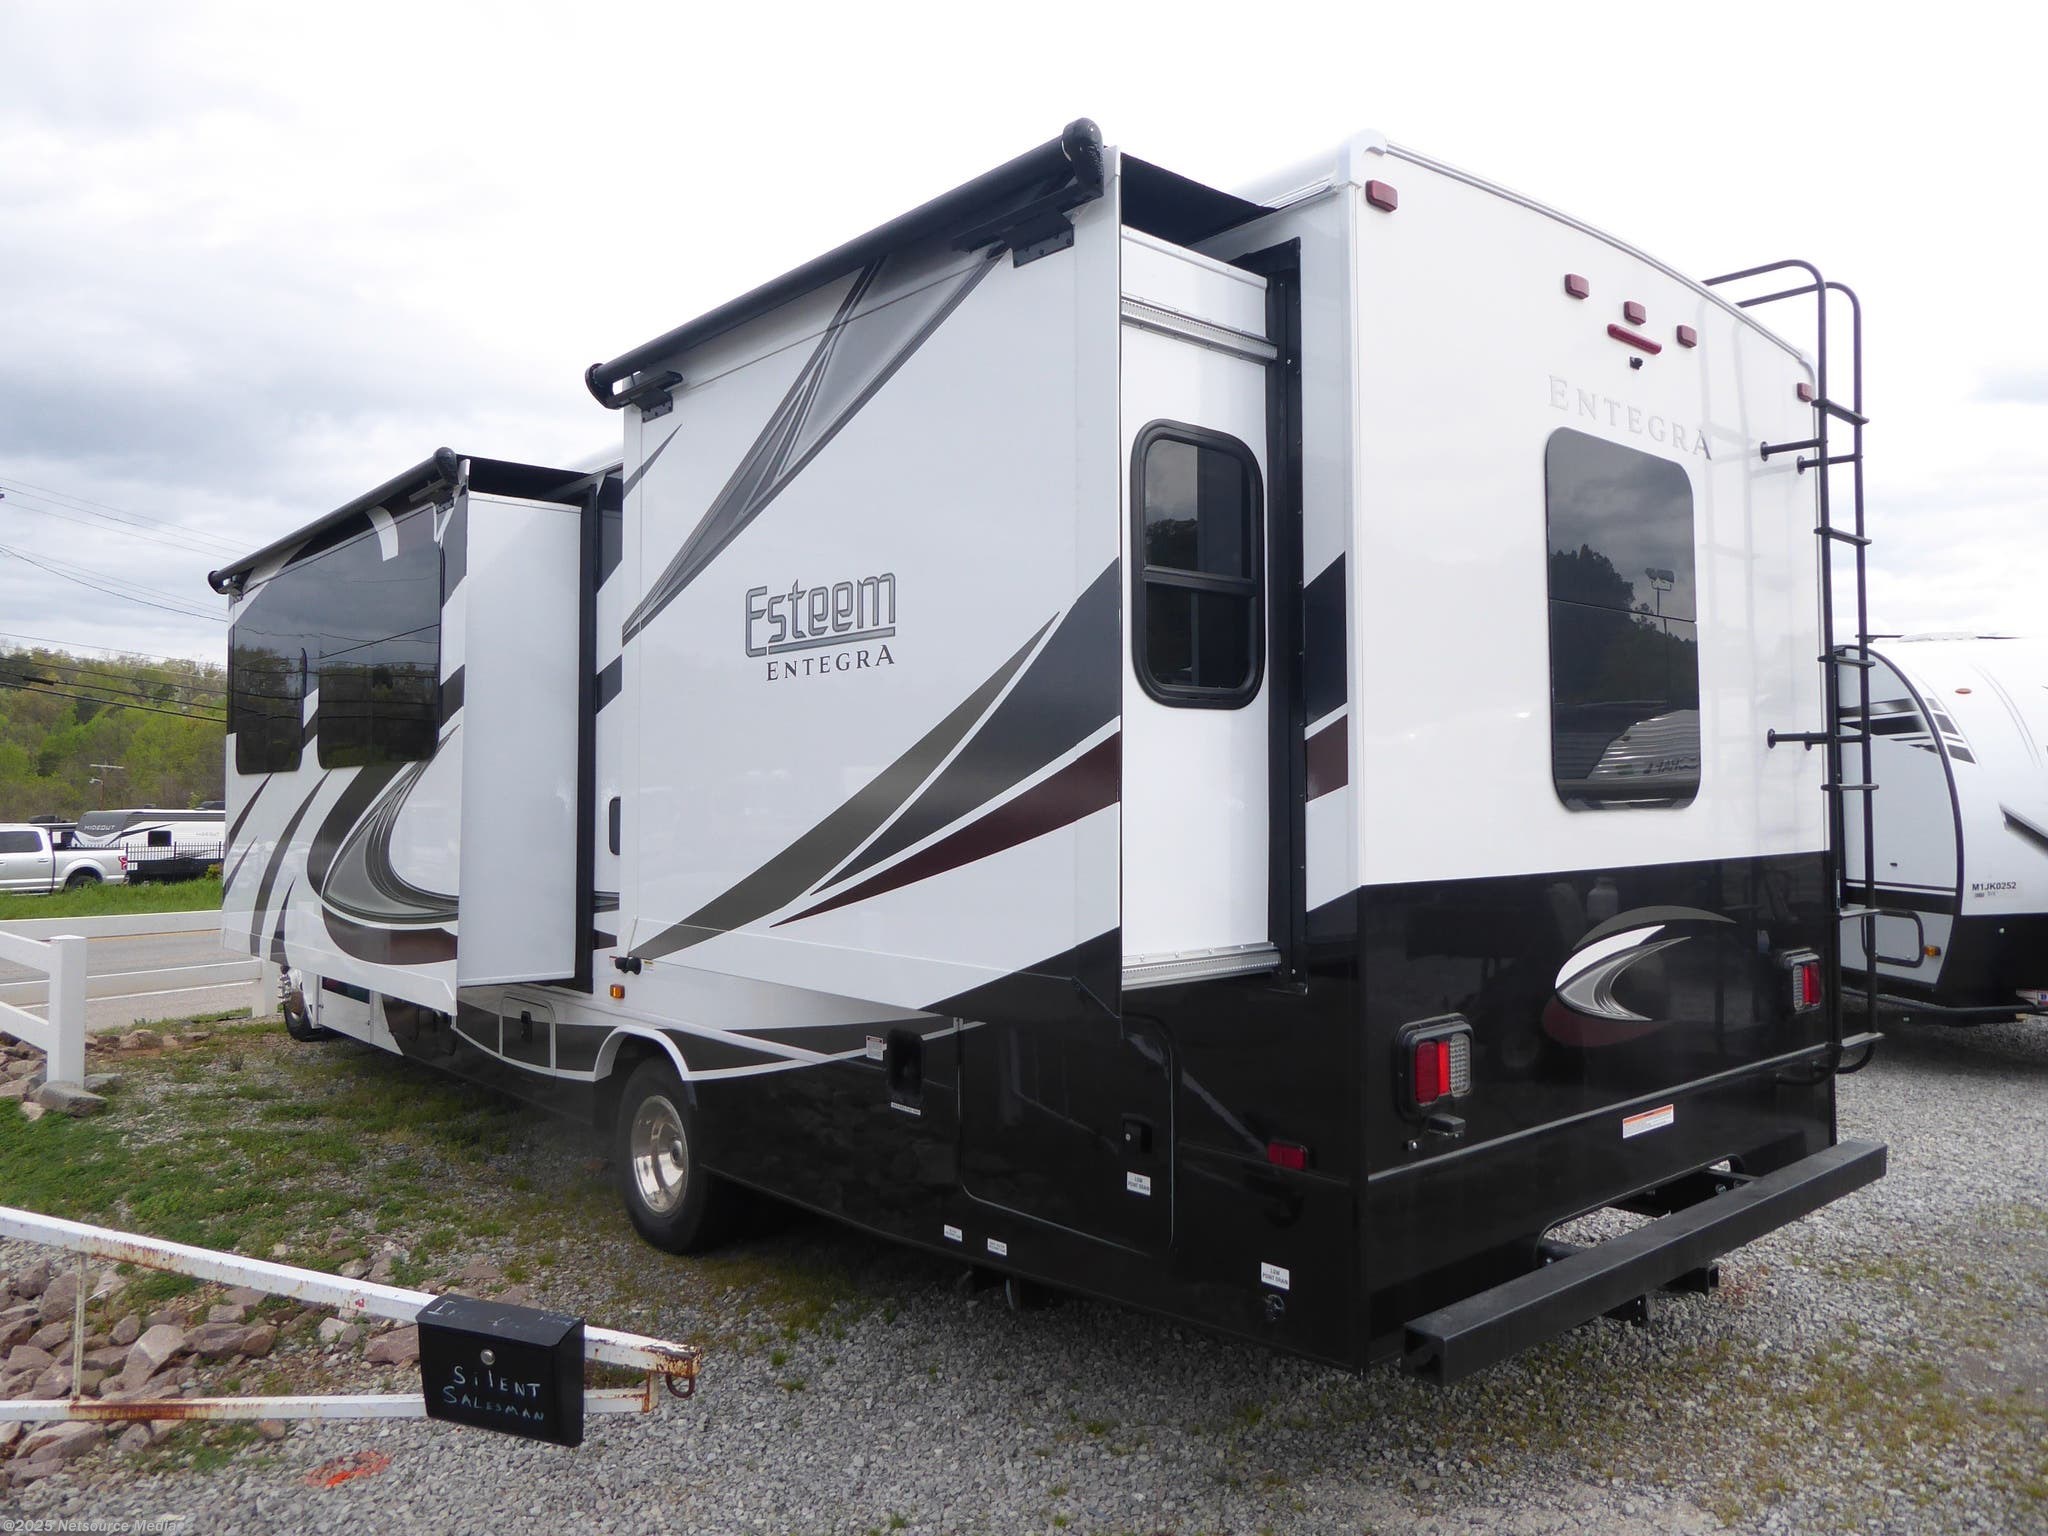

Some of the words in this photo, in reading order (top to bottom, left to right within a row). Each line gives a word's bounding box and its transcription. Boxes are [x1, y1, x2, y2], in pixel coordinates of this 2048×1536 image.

[1548, 374, 1712, 461] ENTEGRA
[745, 572, 896, 658] Esteem
[766, 644, 895, 682] ENTEGRA
[1972, 881, 2017, 891] M1JK0252
[442, 1385, 546, 1422] SALESMAN
